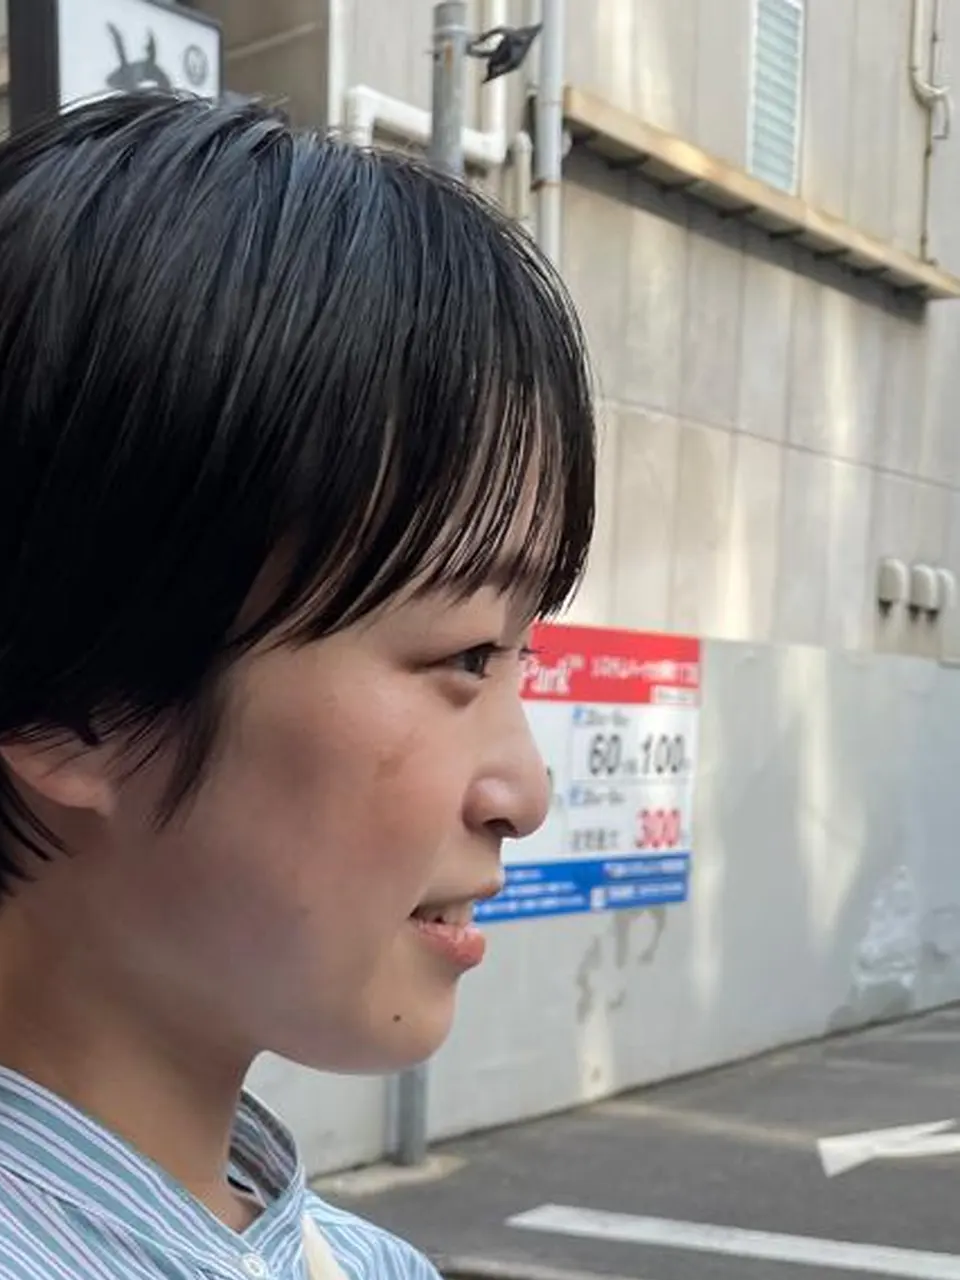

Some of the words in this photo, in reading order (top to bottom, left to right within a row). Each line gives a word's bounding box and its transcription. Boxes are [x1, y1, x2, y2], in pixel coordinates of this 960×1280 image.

[587, 734, 621, 776] 60
[642, 734, 685, 775] 100
[636, 808, 681, 849] 300
